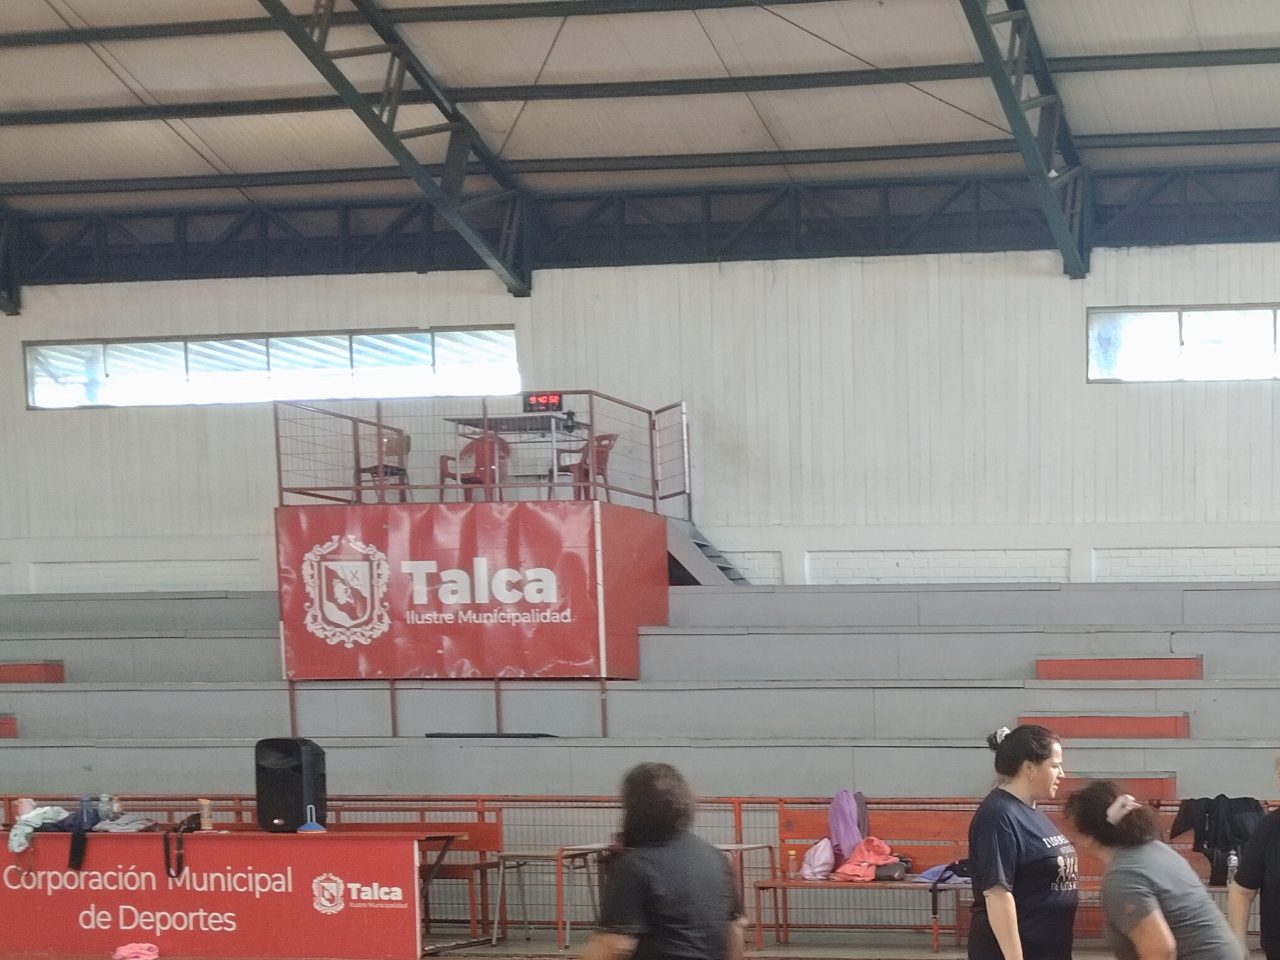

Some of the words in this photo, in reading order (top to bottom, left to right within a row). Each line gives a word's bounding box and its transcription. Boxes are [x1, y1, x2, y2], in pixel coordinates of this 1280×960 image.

[401, 557, 558, 604] Talca
[406, 610, 455, 625] Ilustre
[458, 608, 572, 627] Municipalidad
[3, 864, 157, 896] Corporación
[168, 865, 293, 899] Municipal
[346, 882, 403, 901] Talca
[79, 903, 113, 930] de
[119, 905, 238, 937] Deportes
